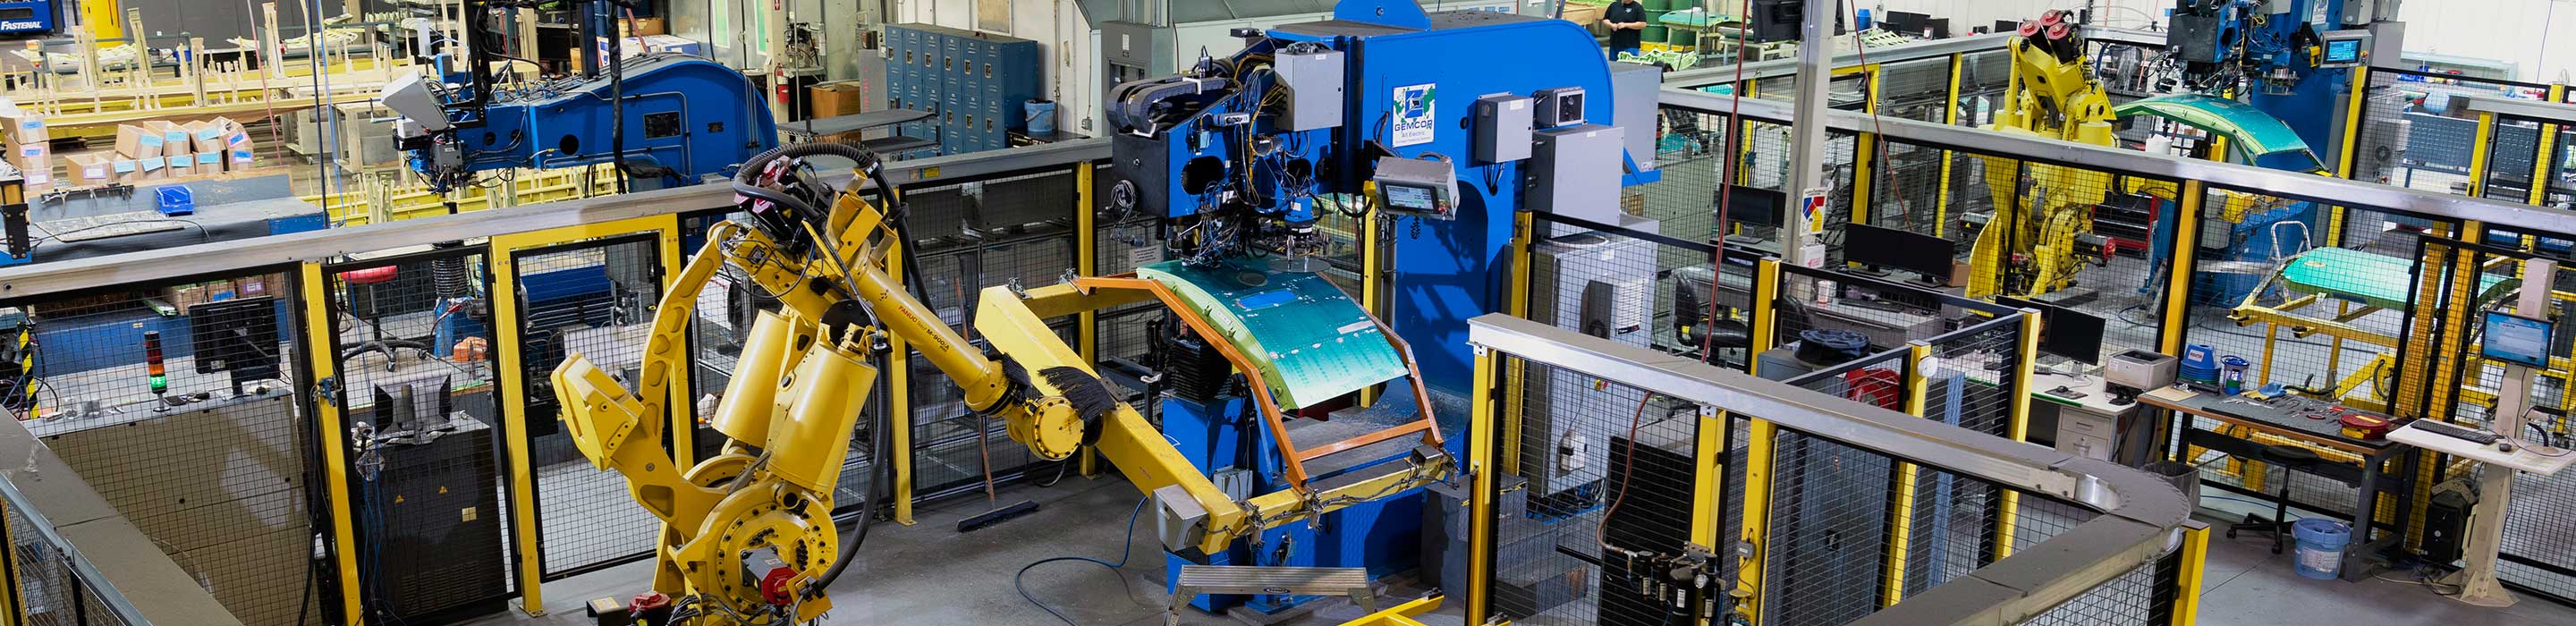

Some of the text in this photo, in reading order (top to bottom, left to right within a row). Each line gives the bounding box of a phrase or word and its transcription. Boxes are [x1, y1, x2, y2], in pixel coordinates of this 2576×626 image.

[1, 21, 42, 30] FASTENAL
[1394, 120, 1433, 131] GEMCOR
[899, 305, 918, 323] FANUC
